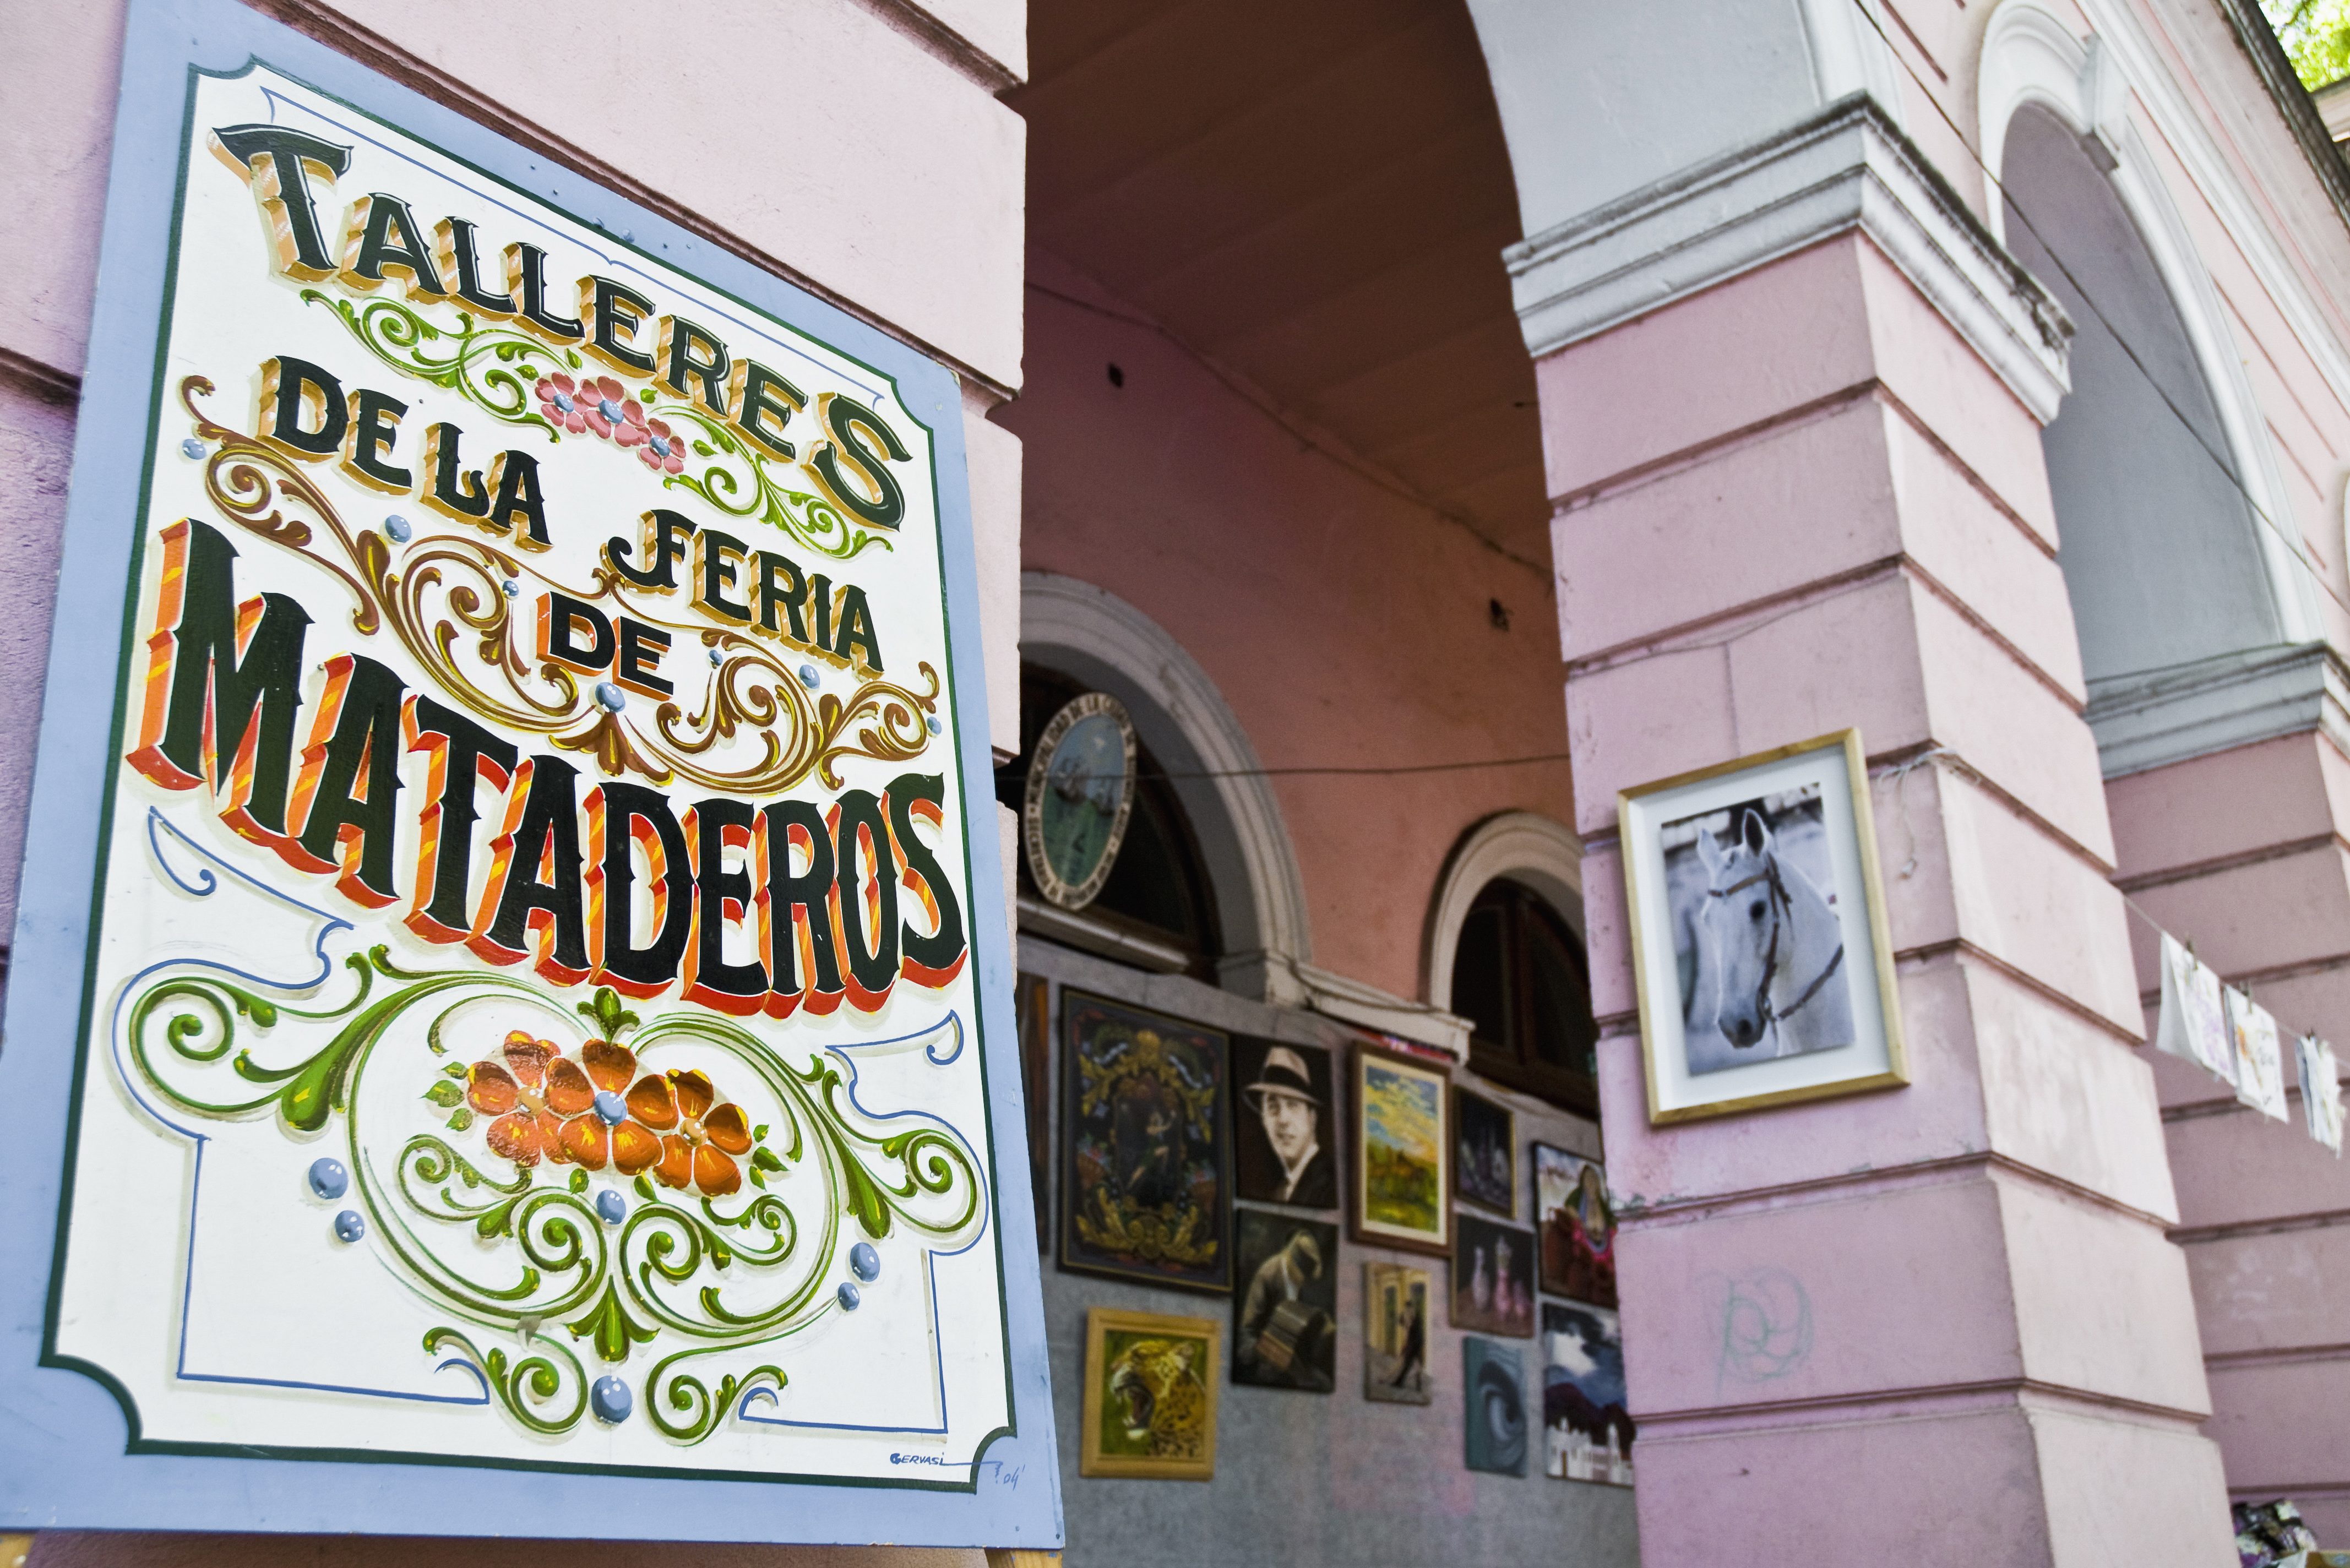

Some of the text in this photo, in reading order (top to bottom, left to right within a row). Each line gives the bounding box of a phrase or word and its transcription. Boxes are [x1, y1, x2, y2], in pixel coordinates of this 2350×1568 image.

[207, 124, 913, 530] TALLERES
[260, 355, 884, 679] DE LA FERIA
[537, 591, 674, 700] DE
[126, 519, 968, 1019] MATADEROS
